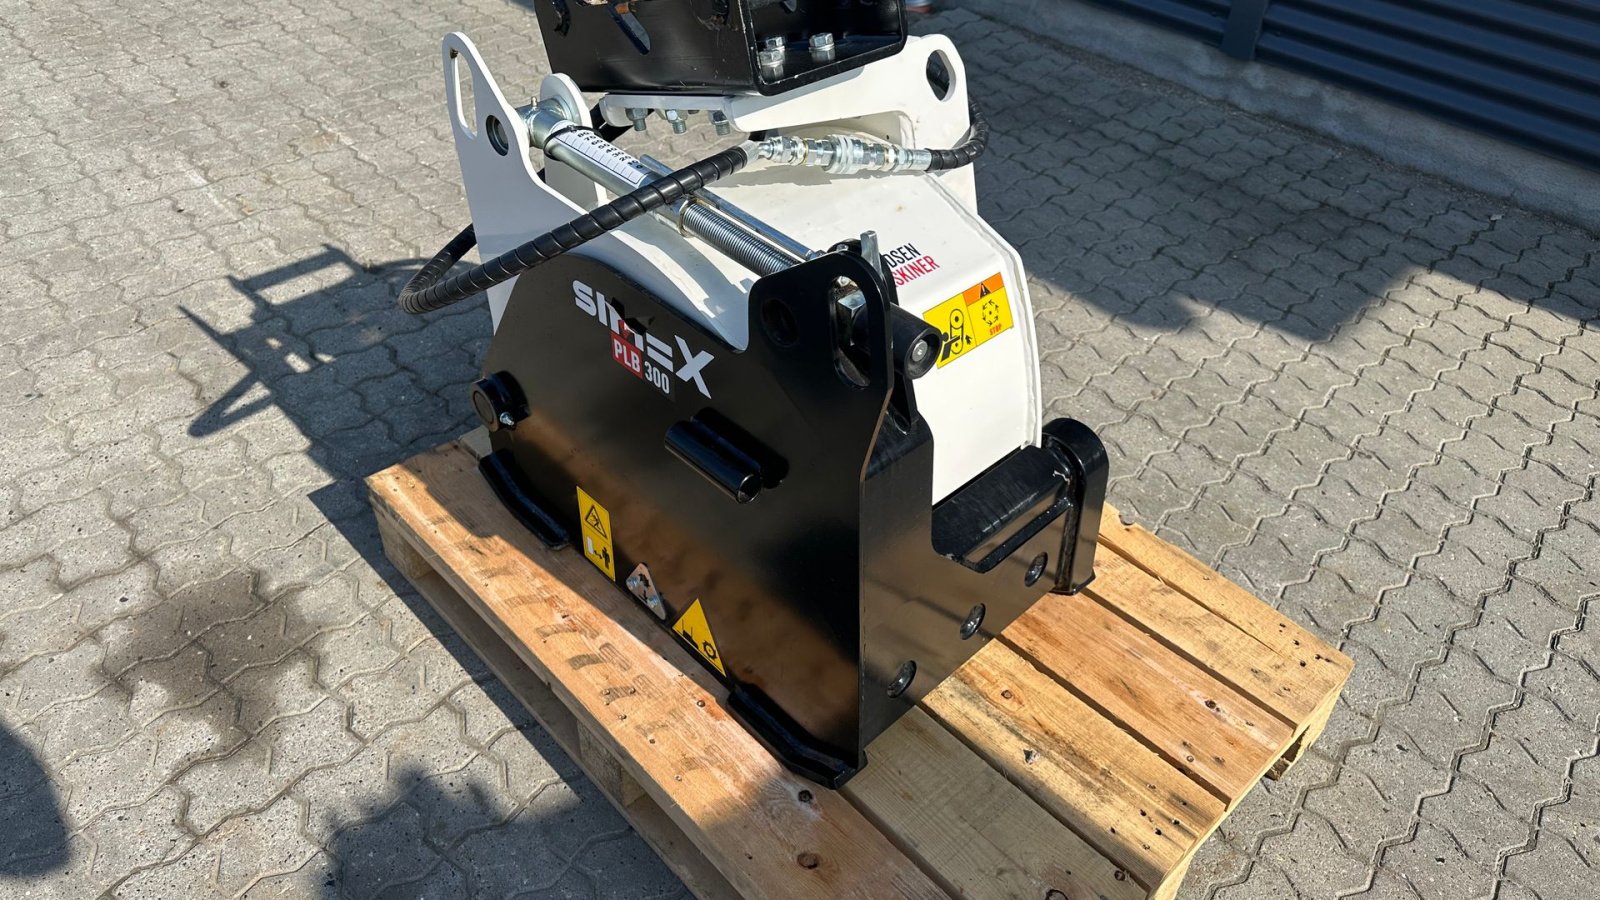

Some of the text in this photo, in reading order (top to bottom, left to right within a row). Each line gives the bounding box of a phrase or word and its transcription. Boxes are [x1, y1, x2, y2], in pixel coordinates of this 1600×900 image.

[882, 242, 921, 269] DSEN
[891, 255, 940, 288] SKINER
[613, 338, 670, 394] PLB 300
